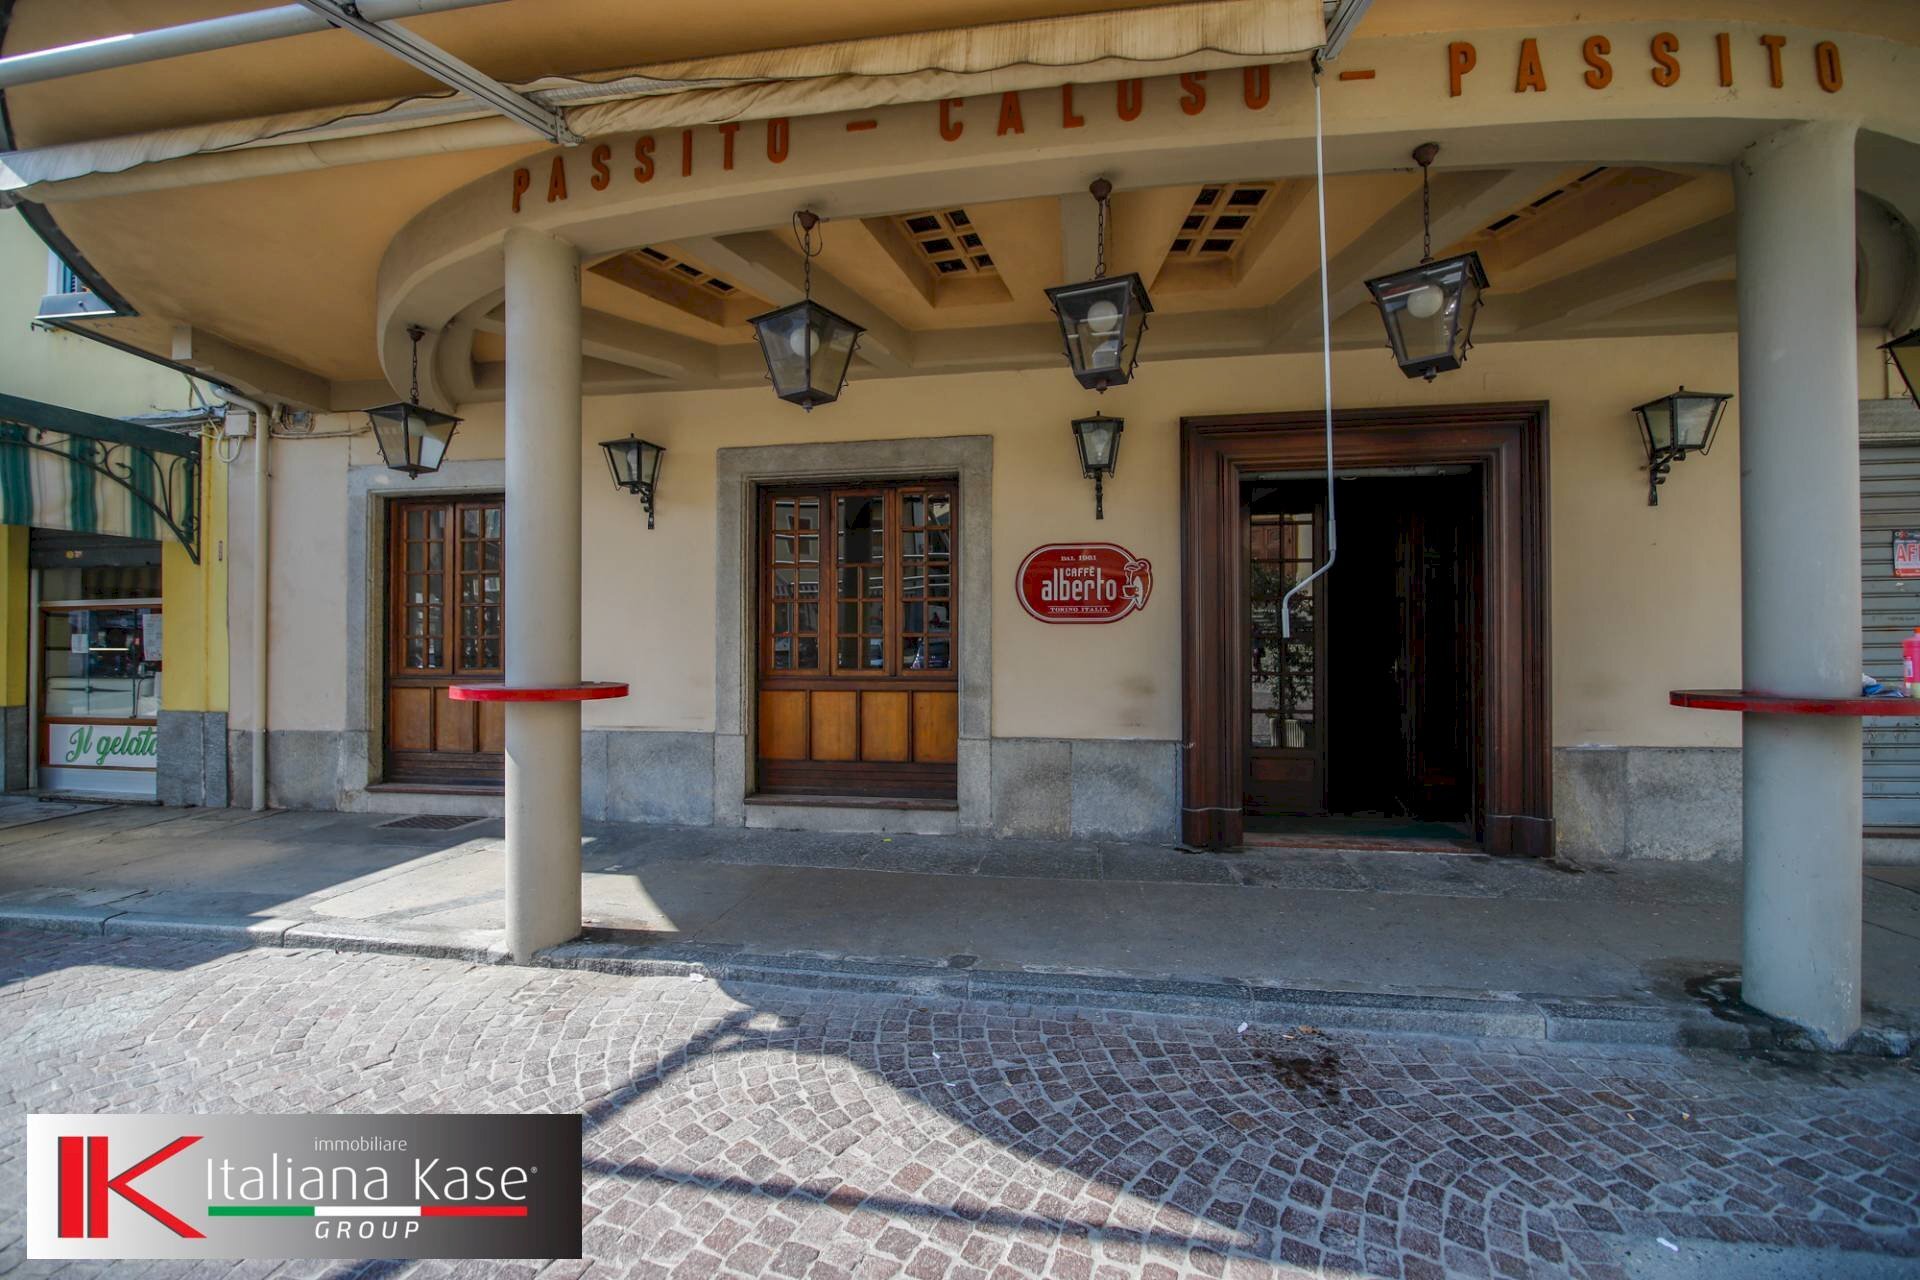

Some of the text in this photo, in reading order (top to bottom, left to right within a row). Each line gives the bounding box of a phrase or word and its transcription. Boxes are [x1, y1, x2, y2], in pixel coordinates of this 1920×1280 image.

[512, 118, 789, 213] PASSITO
[1447, 32, 1843, 98] PASSITO
[1041, 567, 1118, 601] alberto
